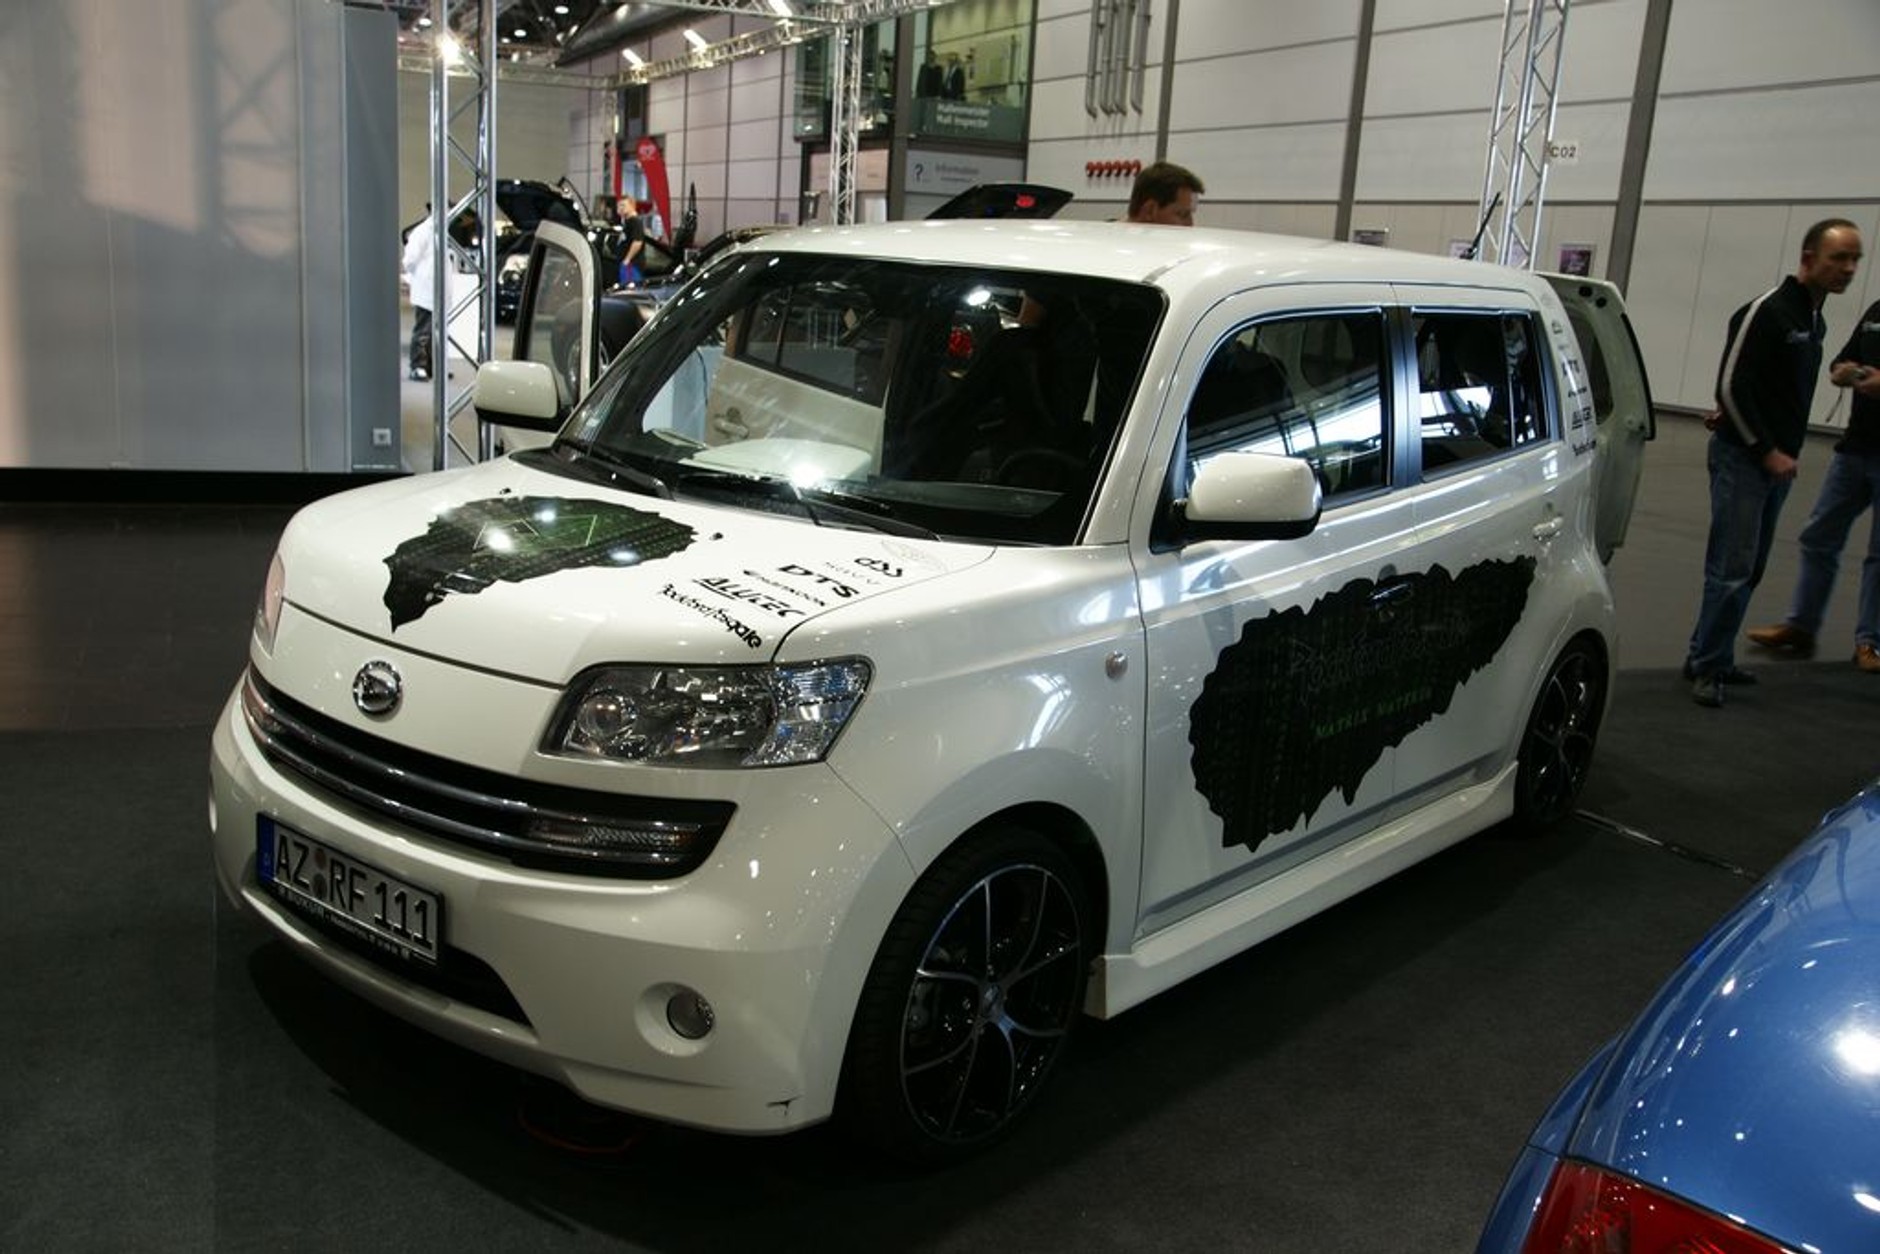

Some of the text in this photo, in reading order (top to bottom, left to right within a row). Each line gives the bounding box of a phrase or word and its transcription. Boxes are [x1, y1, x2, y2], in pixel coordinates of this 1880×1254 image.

[777, 564, 860, 599] DTS
[275, 834, 311, 889] AZ
[330, 858, 369, 912] RF
[374, 881, 434, 950] 111
